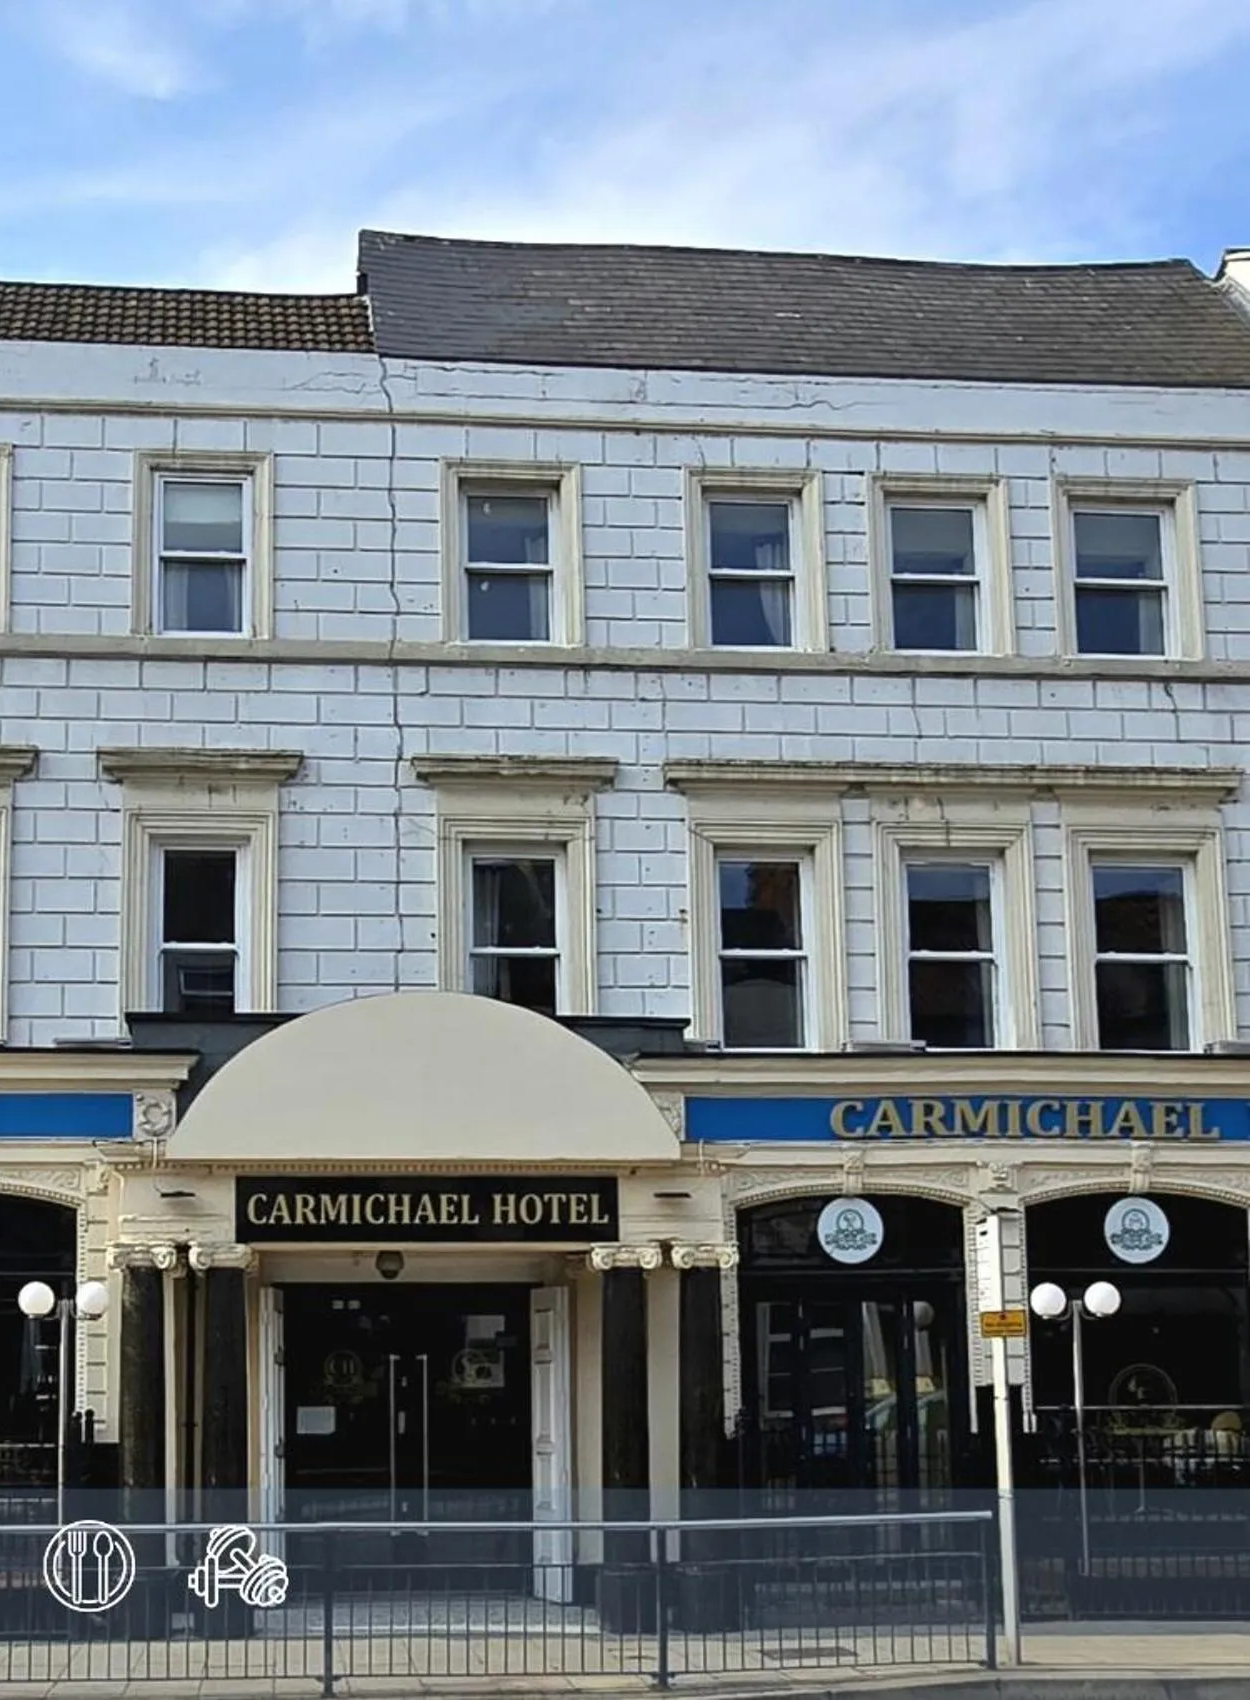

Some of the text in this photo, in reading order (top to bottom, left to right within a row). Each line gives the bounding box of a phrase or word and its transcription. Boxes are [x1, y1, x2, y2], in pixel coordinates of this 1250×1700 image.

[829, 1099, 1221, 1139] CARMICHAEL
[247, 1193, 610, 1225] CARMICHAEL HOTEL
